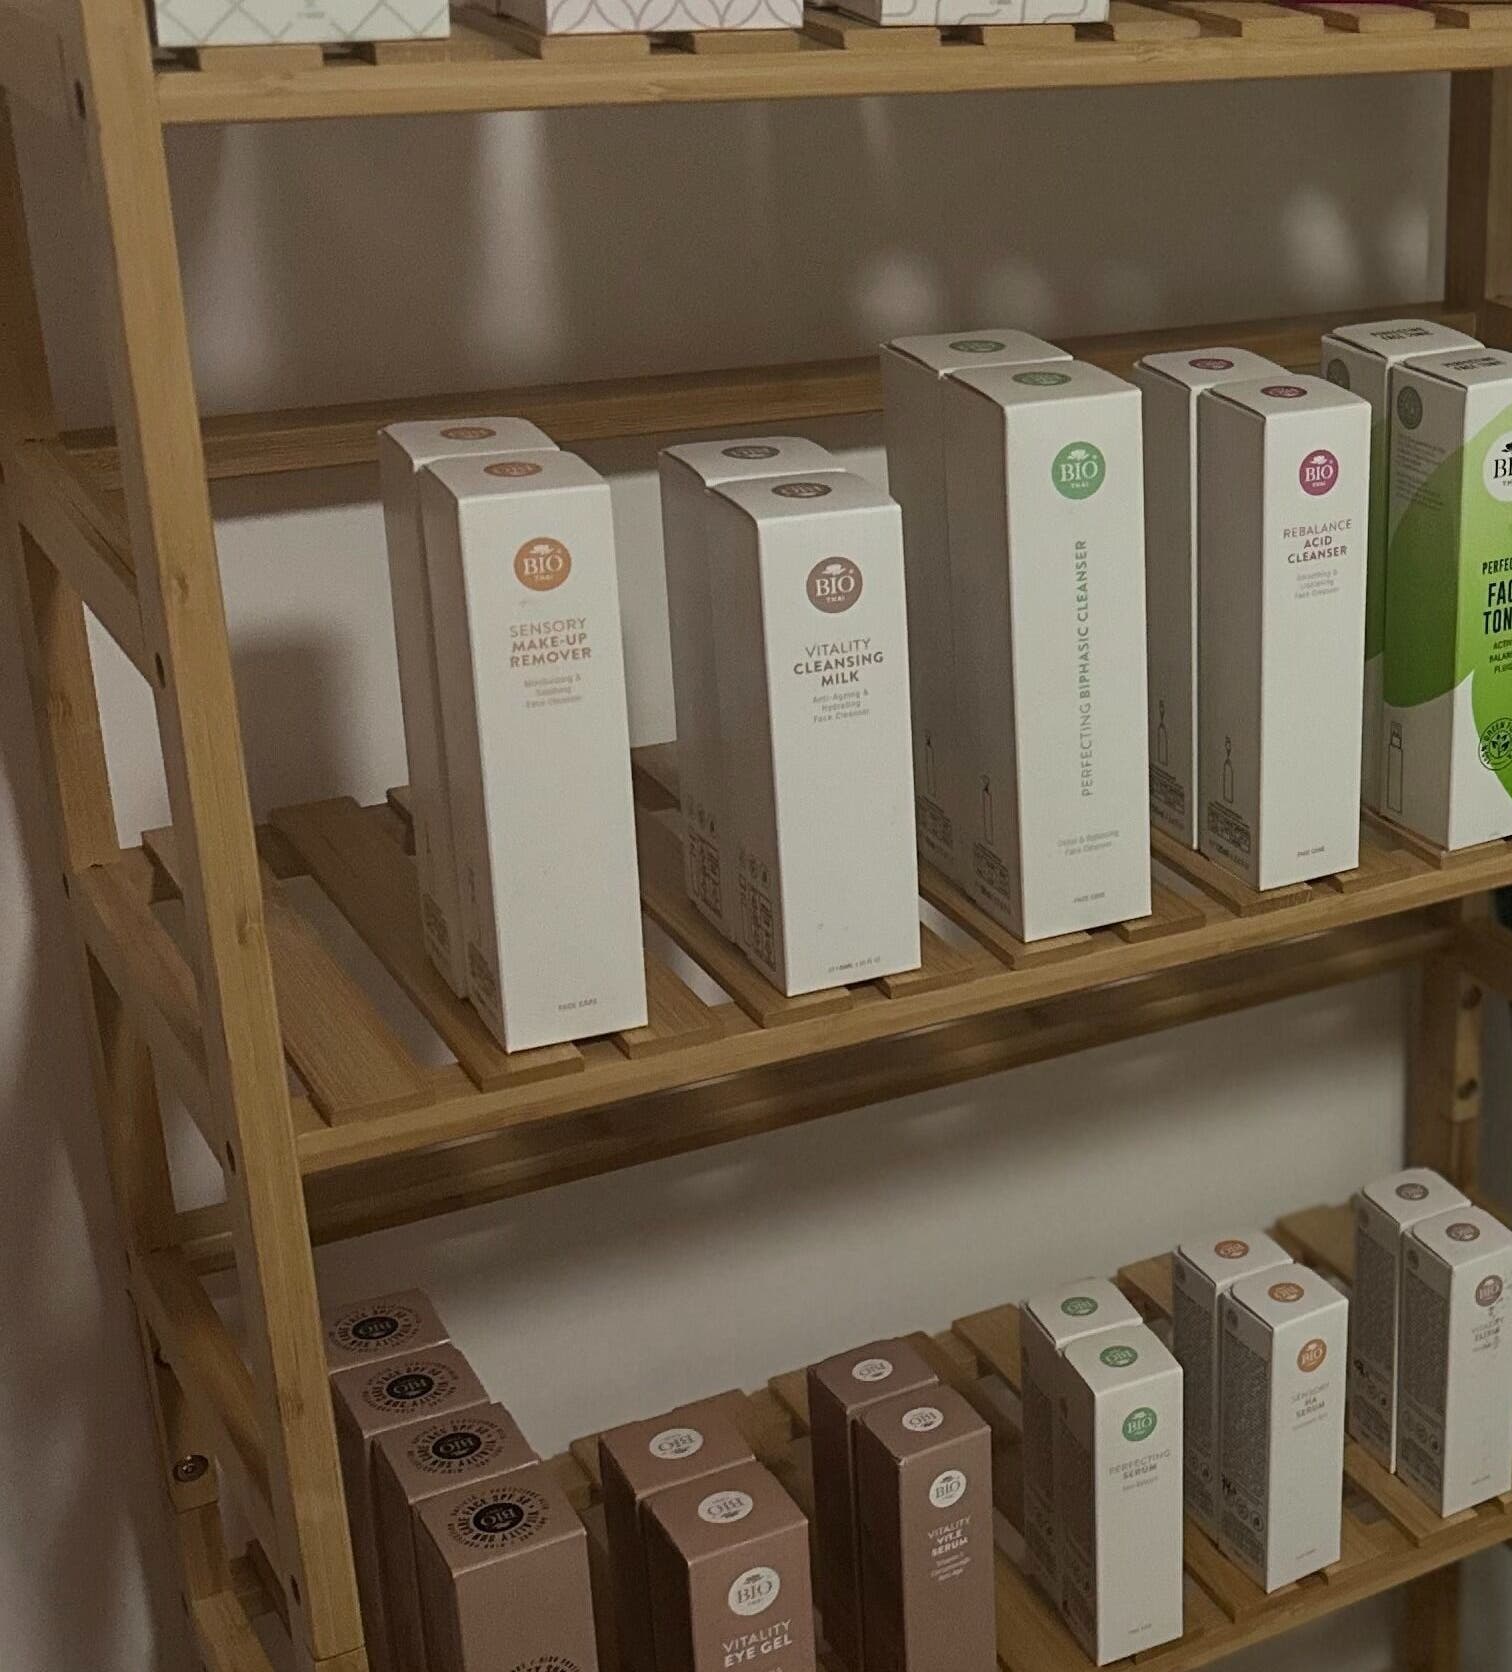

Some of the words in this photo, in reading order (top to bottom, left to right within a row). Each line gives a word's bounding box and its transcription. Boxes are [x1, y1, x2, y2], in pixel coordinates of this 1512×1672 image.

[1060, 460, 1098, 482] BIO
[1305, 464, 1334, 482] BIO
[1283, 518, 1353, 540] REBALANCE
[1304, 535, 1332, 550] ACID
[522, 554, 563, 576] BIO
[1287, 545, 1348, 564] CLEANSER
[816, 575, 856, 597] BIO
[1075, 540, 1090, 622] CLEANSER
[509, 617, 586, 638] SENSORY
[512, 632, 588, 653] MAKE-UP
[804, 638, 871, 659] VITALITY
[510, 646, 592, 668] REMOVER
[793, 651, 884, 675] CLEANSING
[1077, 626, 1091, 700] BIPHASIC
[821, 670, 859, 688] MILK
[1079, 702, 1094, 798] PERFECTING
[1128, 1416, 1152, 1434] BIO
[440, 1438, 474, 1453] BIO
[1108, 1448, 1172, 1476] PERFECTING
[1123, 1463, 1158, 1479] SERUM
[936, 1480, 961, 1498] BIO
[480, 1508, 514, 1526] BIO
[928, 1514, 972, 1539] VITALITY
[931, 1537, 968, 1557] SERUM
[737, 1580, 772, 1604] BIO
[722, 1618, 792, 1654] VITALITY
[724, 1646, 758, 1668] EYE
[760, 1634, 793, 1654] GEL
